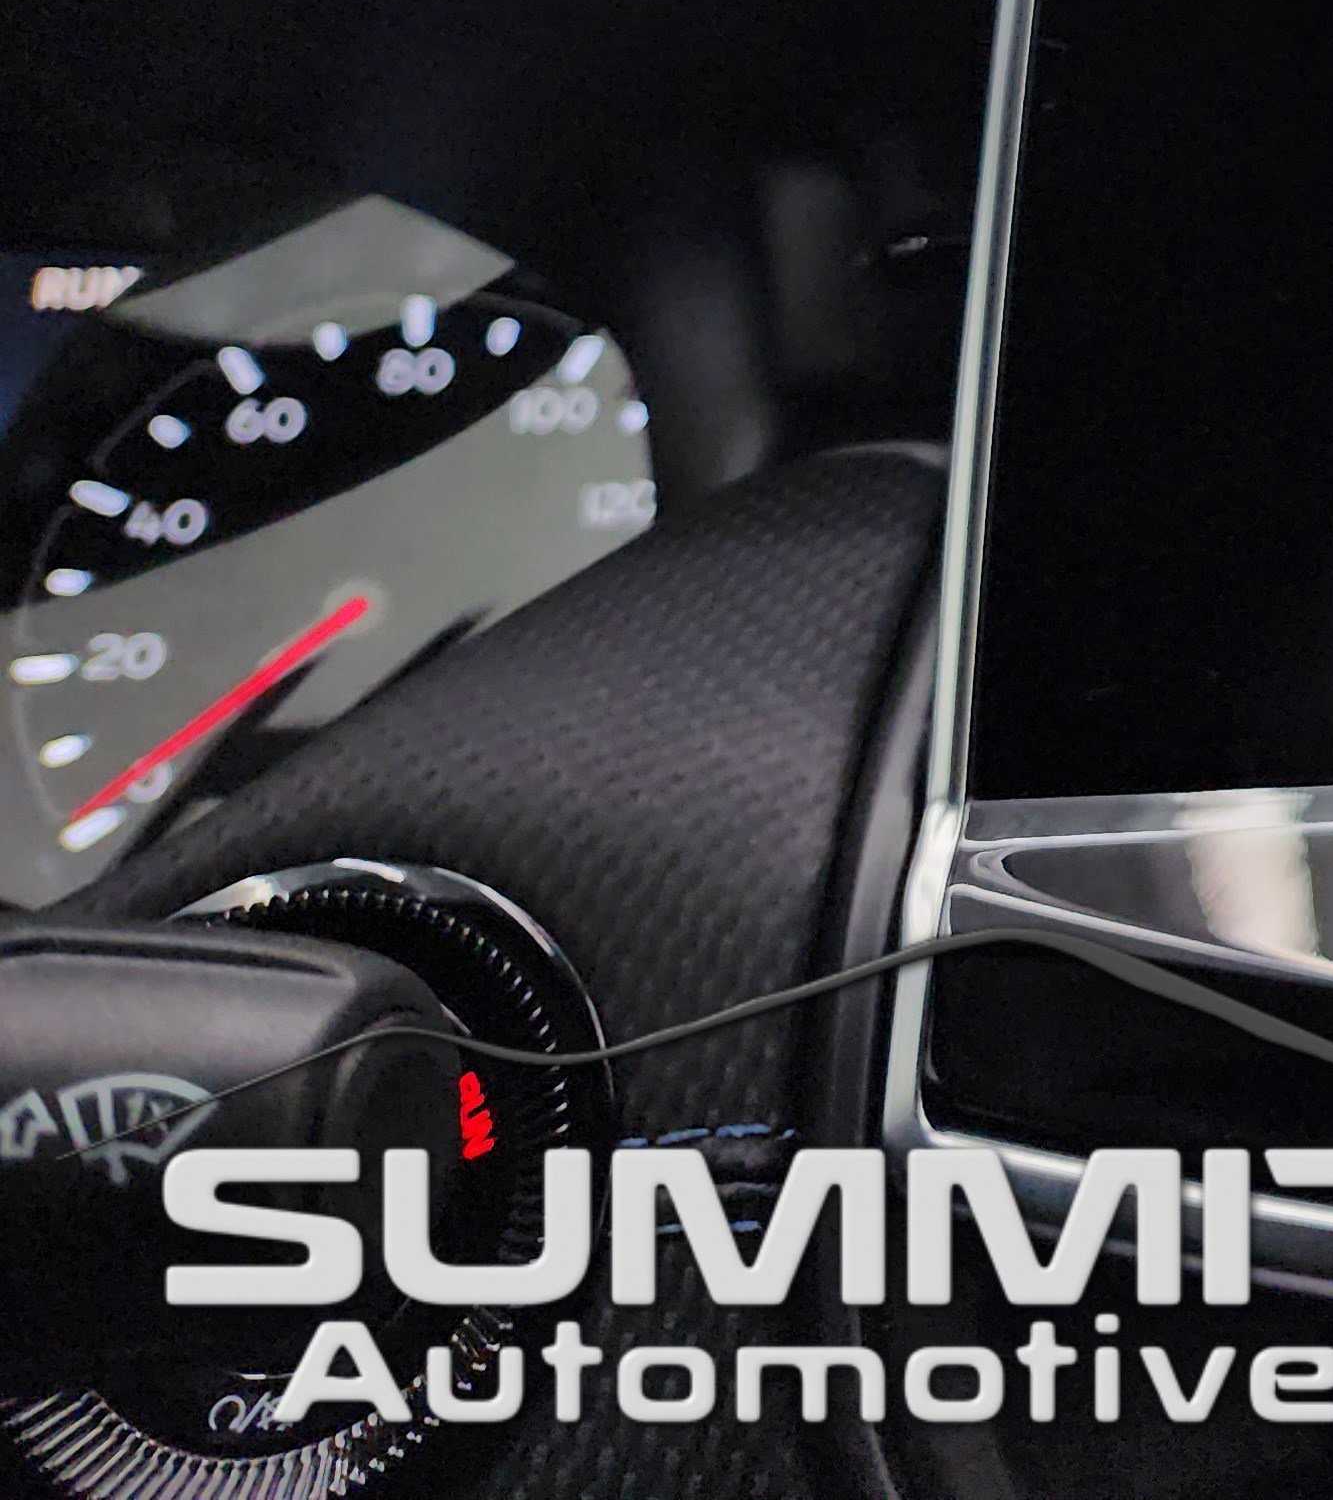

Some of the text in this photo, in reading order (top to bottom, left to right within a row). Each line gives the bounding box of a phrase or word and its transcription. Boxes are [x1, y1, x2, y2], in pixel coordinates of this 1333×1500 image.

[377, 348, 456, 395] 80
[226, 396, 307, 444] 60
[509, 386, 600, 435] 100
[125, 498, 208, 545] 40
[82, 632, 167, 681] 20
